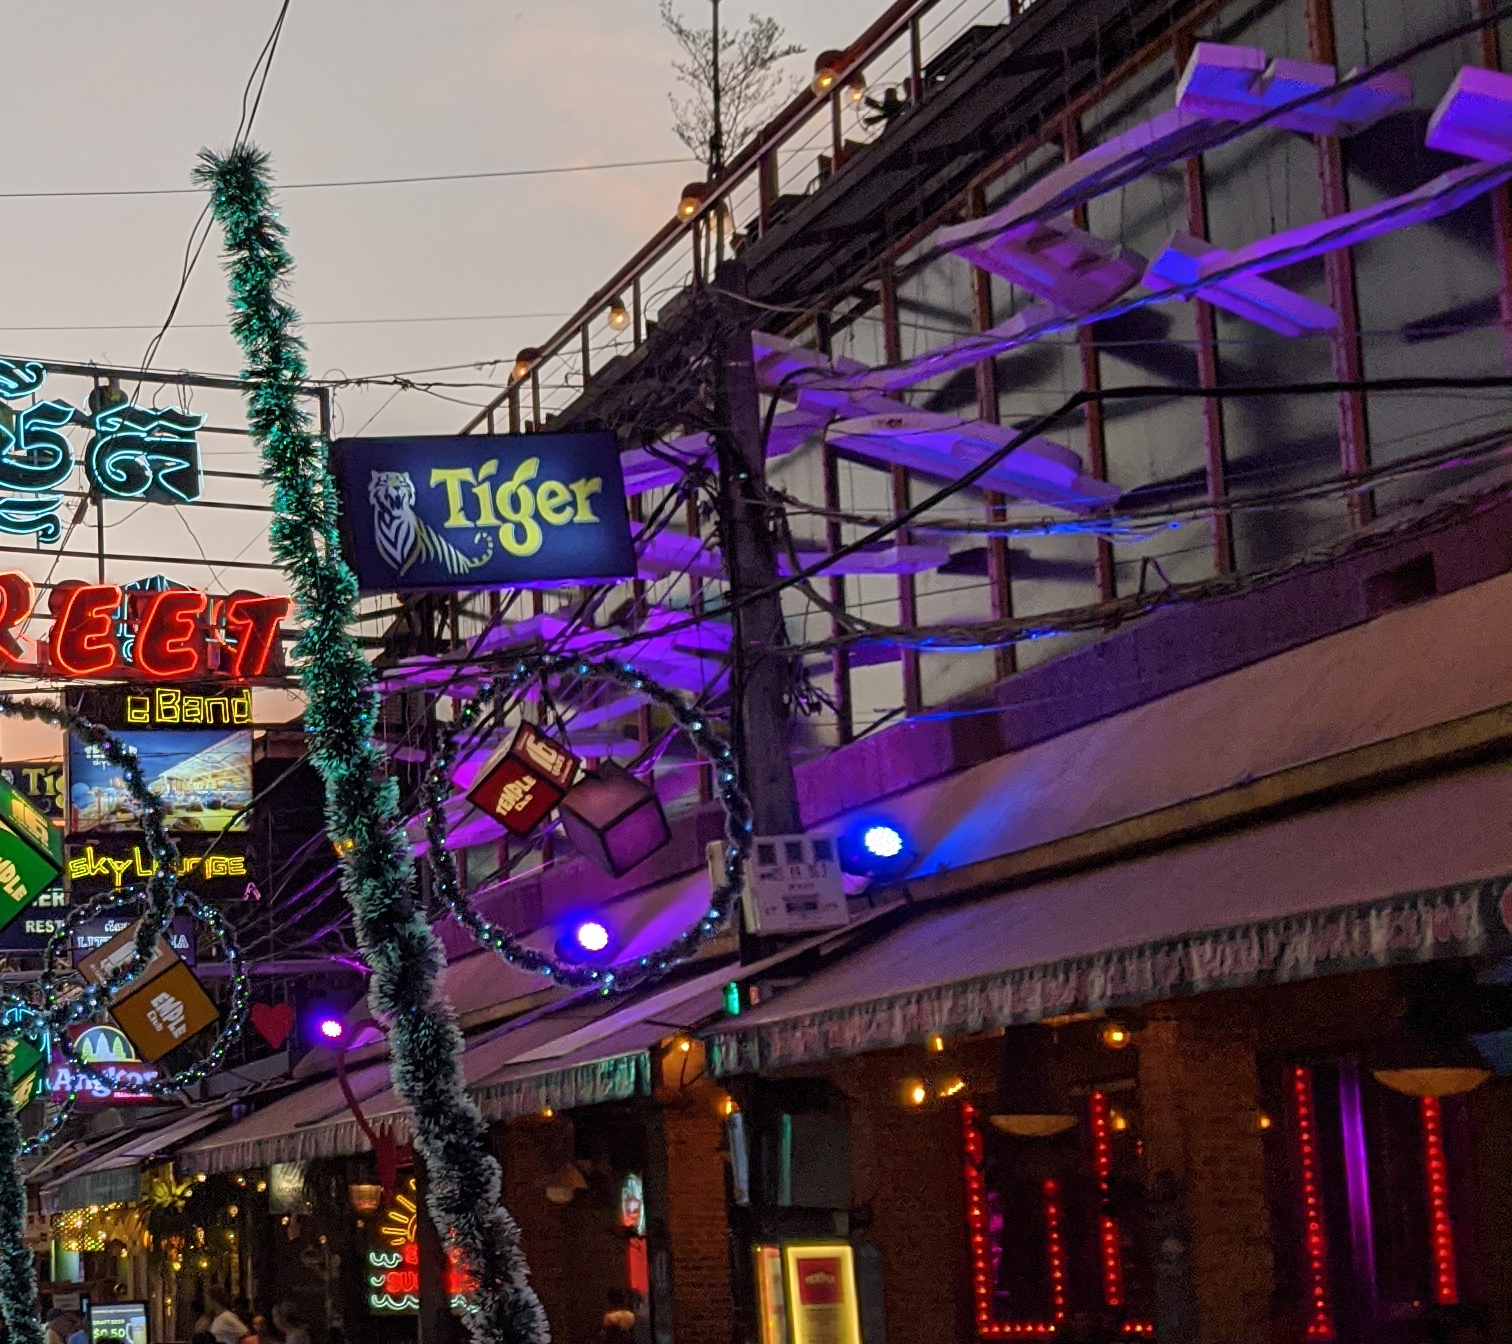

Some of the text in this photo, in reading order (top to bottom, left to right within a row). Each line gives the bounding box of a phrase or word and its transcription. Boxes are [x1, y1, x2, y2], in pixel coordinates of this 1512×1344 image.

[429, 456, 603, 557] Tiger
[155, 687, 253, 724] Band
[495, 774, 538, 817] TEMPLE
